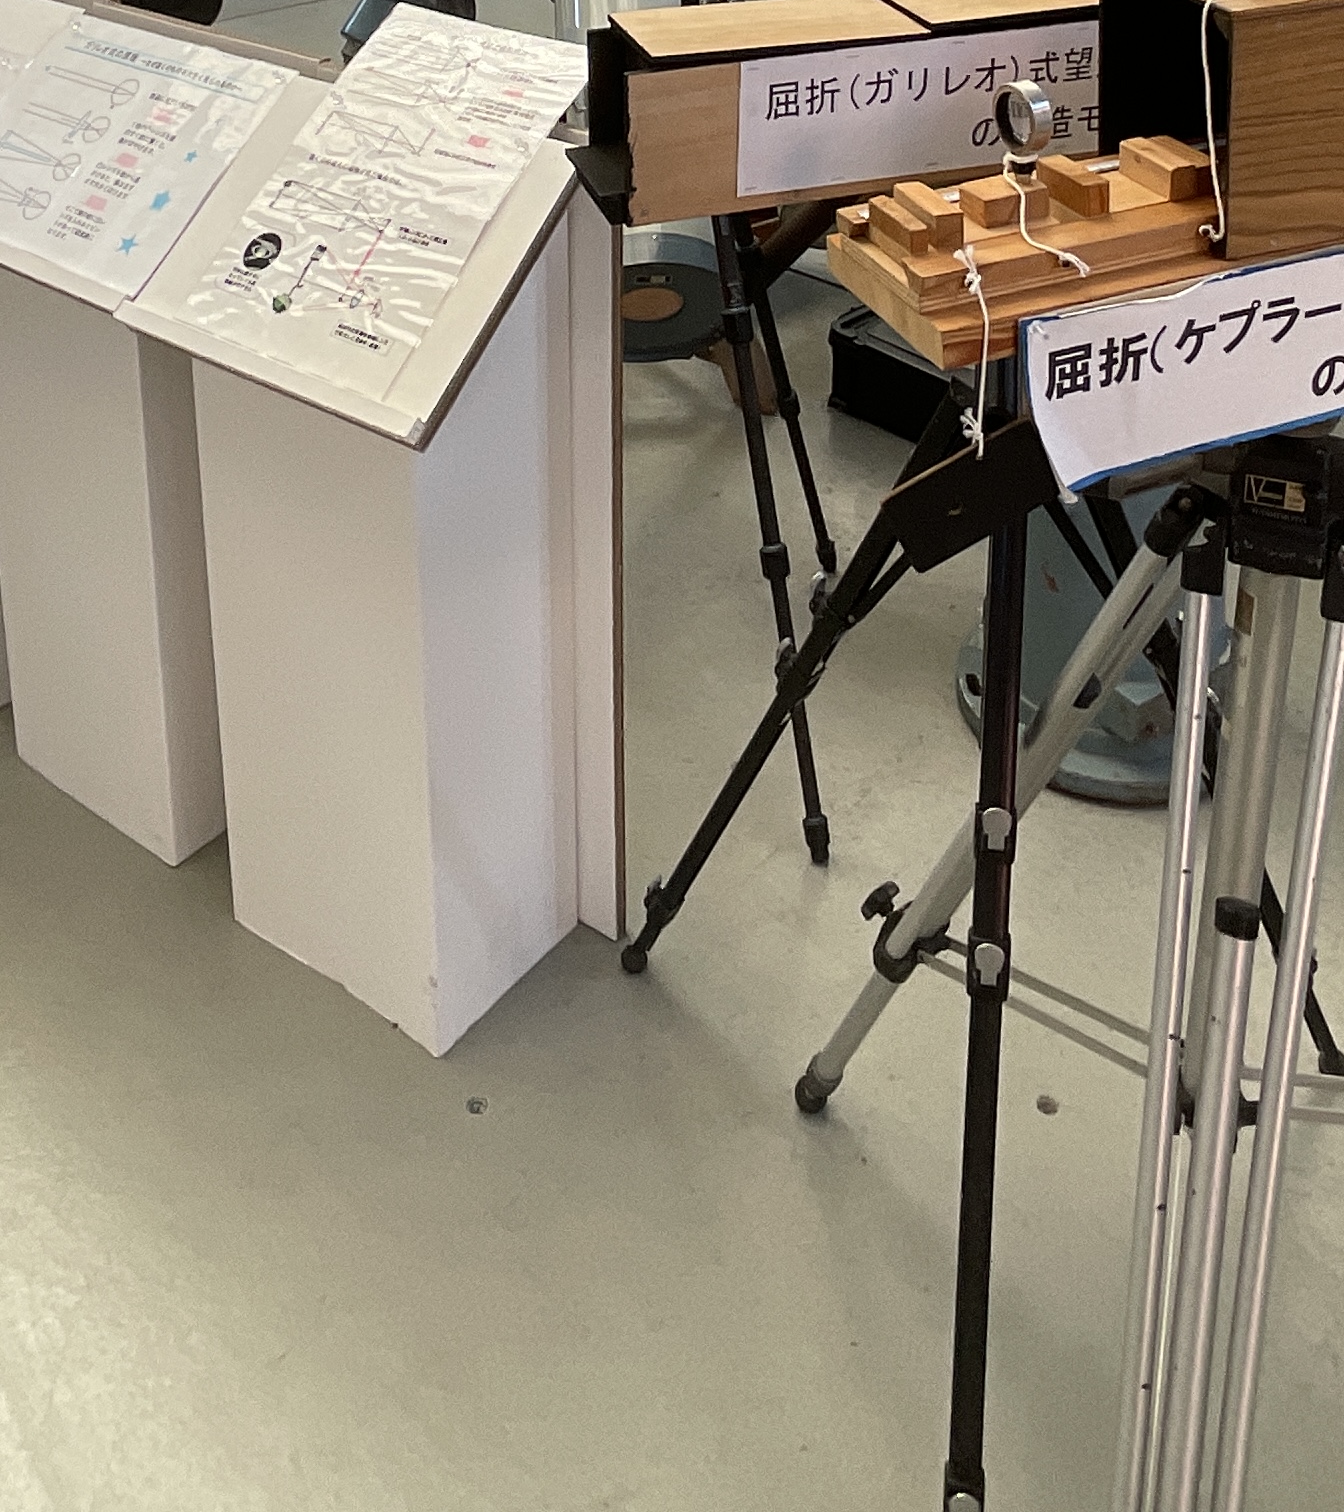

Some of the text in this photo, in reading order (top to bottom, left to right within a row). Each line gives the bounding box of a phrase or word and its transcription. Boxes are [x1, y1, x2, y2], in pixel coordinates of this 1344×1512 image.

[765, 46, 1099, 122] 屈折(ガリレオ)式望
[971, 105, 1099, 147] の造モ
